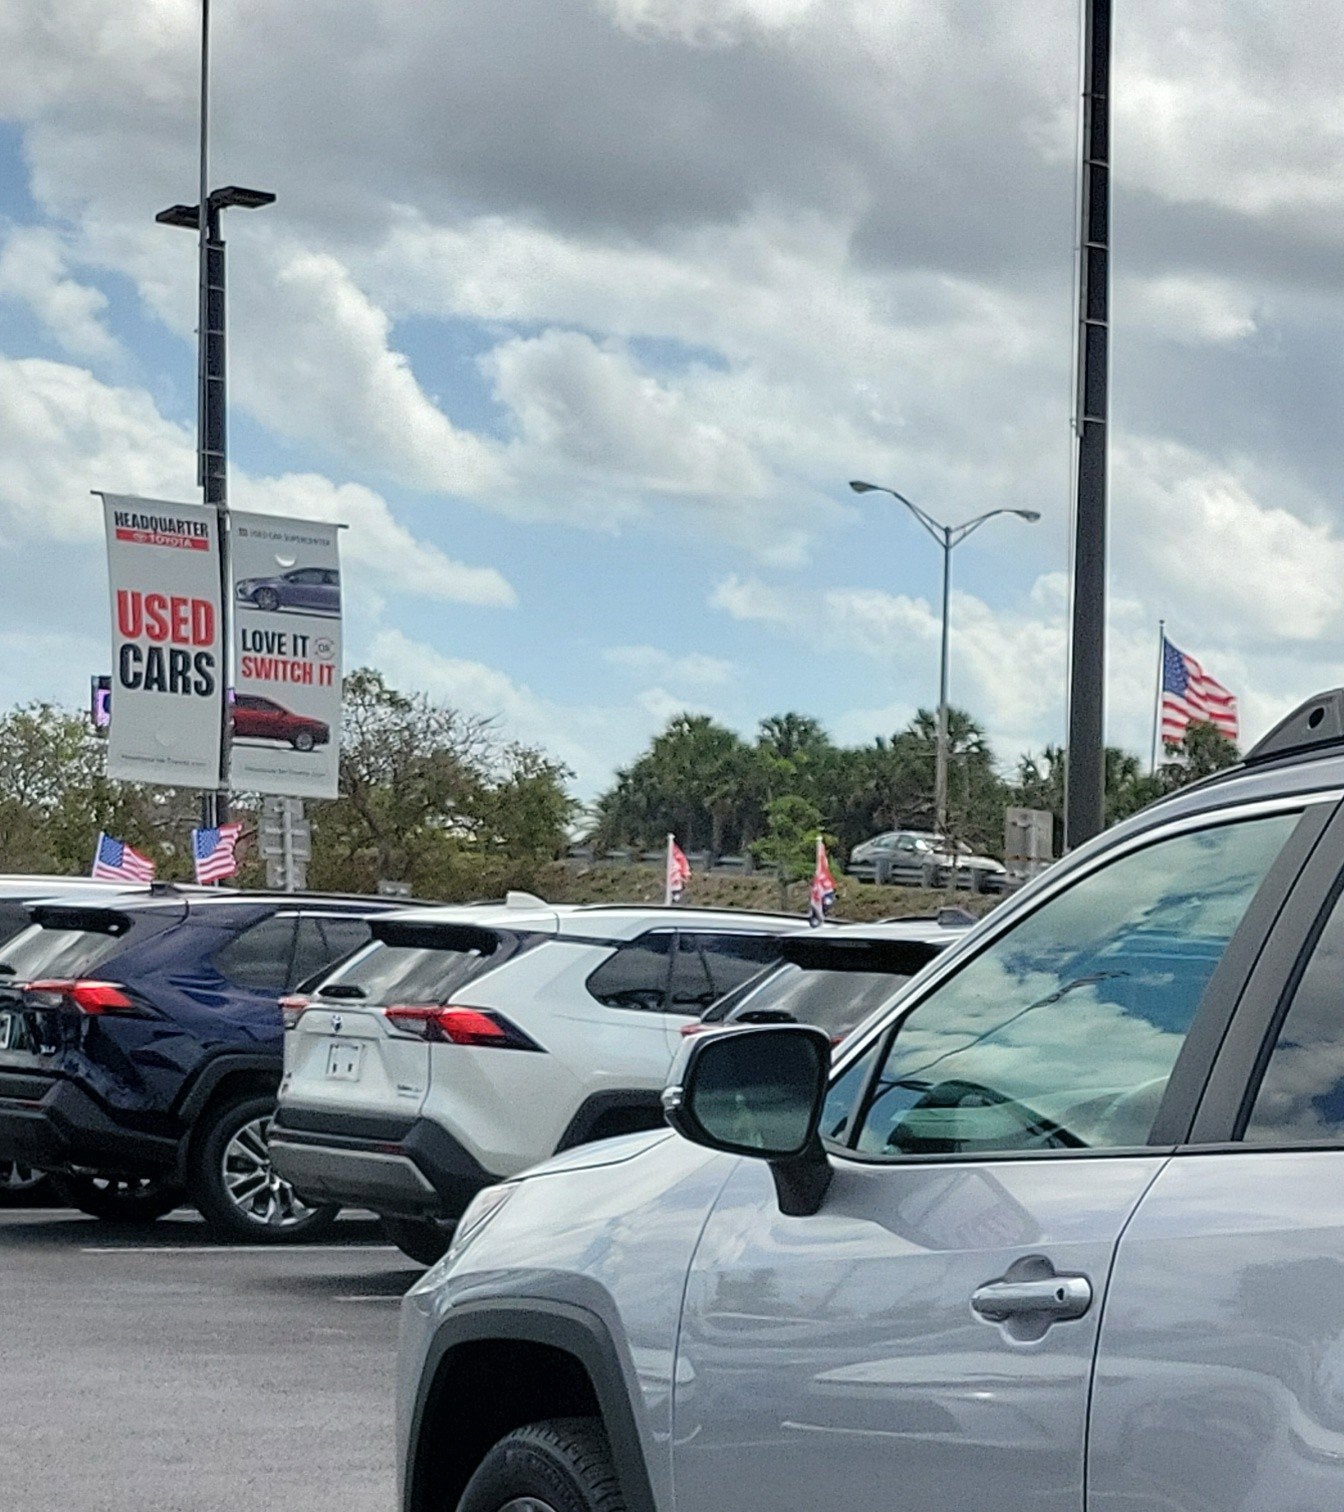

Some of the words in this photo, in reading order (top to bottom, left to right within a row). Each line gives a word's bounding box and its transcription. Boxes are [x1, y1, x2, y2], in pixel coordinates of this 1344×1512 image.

[114, 510, 209, 538] HEADQUARTER
[147, 534, 193, 549] TOYOTA
[116, 589, 215, 647] USED
[241, 628, 287, 656] LOVE
[292, 633, 310, 658] IT
[119, 642, 216, 698] CARS
[241, 655, 314, 686] SWITCH
[319, 663, 336, 687] IT
